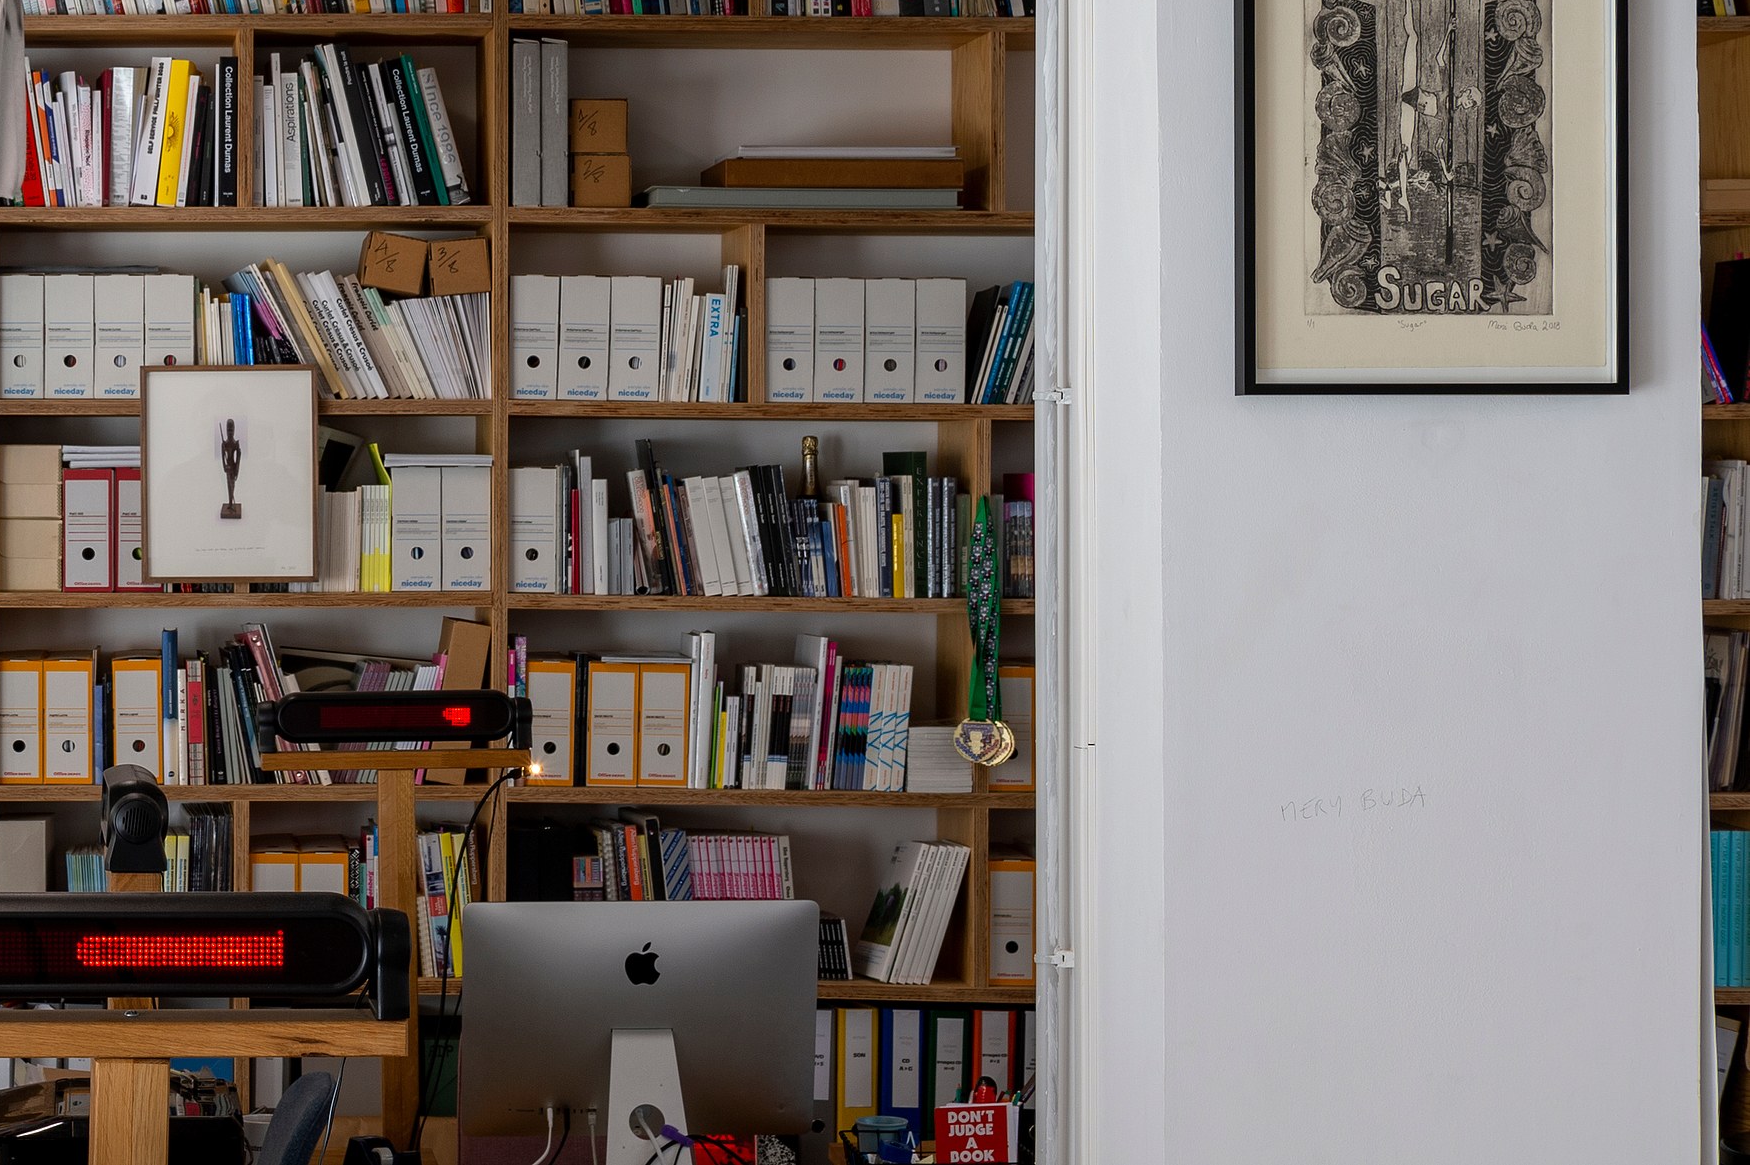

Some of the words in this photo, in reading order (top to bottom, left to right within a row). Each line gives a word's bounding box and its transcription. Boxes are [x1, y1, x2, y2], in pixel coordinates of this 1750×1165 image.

[151, 76, 163, 115] FALL/WINTER
[223, 65, 234, 108] Collection
[391, 67, 409, 111] Collection
[282, 81, 298, 142] Aspirations
[148, 115, 158, 140] SERVICE
[223, 109, 234, 142] Laurent
[400, 109, 417, 143] Laurent
[146, 139, 154, 154] SELF
[434, 123, 457, 165] 1986
[223, 143, 234, 173] Dumas
[408, 142, 423, 173] Dumas
[1375, 264, 1492, 313] SUGAR
[310, 298, 326, 320] Curlet
[319, 298, 336, 321] Curlet
[334, 296, 350, 319] Curlet
[335, 280, 355, 311] François
[349, 309, 366, 333] Curlet
[349, 280, 369, 311] François
[362, 308, 380, 332] Curlet
[708, 298, 722, 337] EXTRA
[320, 319, 337, 344] Crésus
[329, 319, 347, 344] Crésus
[344, 318, 360, 343] Crésus
[331, 341, 340, 349] &
[340, 341, 350, 350] &
[354, 340, 363, 348] &
[334, 347, 351, 372] Crusoé
[342, 347, 361, 373] Crusoé
[357, 346, 374, 372] Crusoé
[3, 387, 35, 396] niceday
[53, 387, 85, 396] niceday
[104, 387, 136, 396] niceday
[516, 387, 548, 398] niceday
[567, 388, 599, 398] niceday
[617, 389, 650, 398] niceday
[772, 390, 804, 400] niceday
[822, 390, 855, 400] niceday
[873, 391, 906, 401] niceday
[923, 391, 956, 401] niceday
[401, 579, 433, 589] niceday
[450, 579, 483, 589] niceday
[515, 580, 548, 590] niceday
[1360, 785, 1428, 812] BUDA
[616, 829, 626, 846] Allen
[629, 828, 637, 844] Allen
[617, 845, 628, 886] Ruppersberg
[630, 843, 641, 885] Ruppersberg
[947, 1110, 995, 1124] DON'T
[948, 1123, 994, 1137] JUDGE
[965, 1137, 978, 1149] A
[950, 1149, 995, 1163] BOOK
